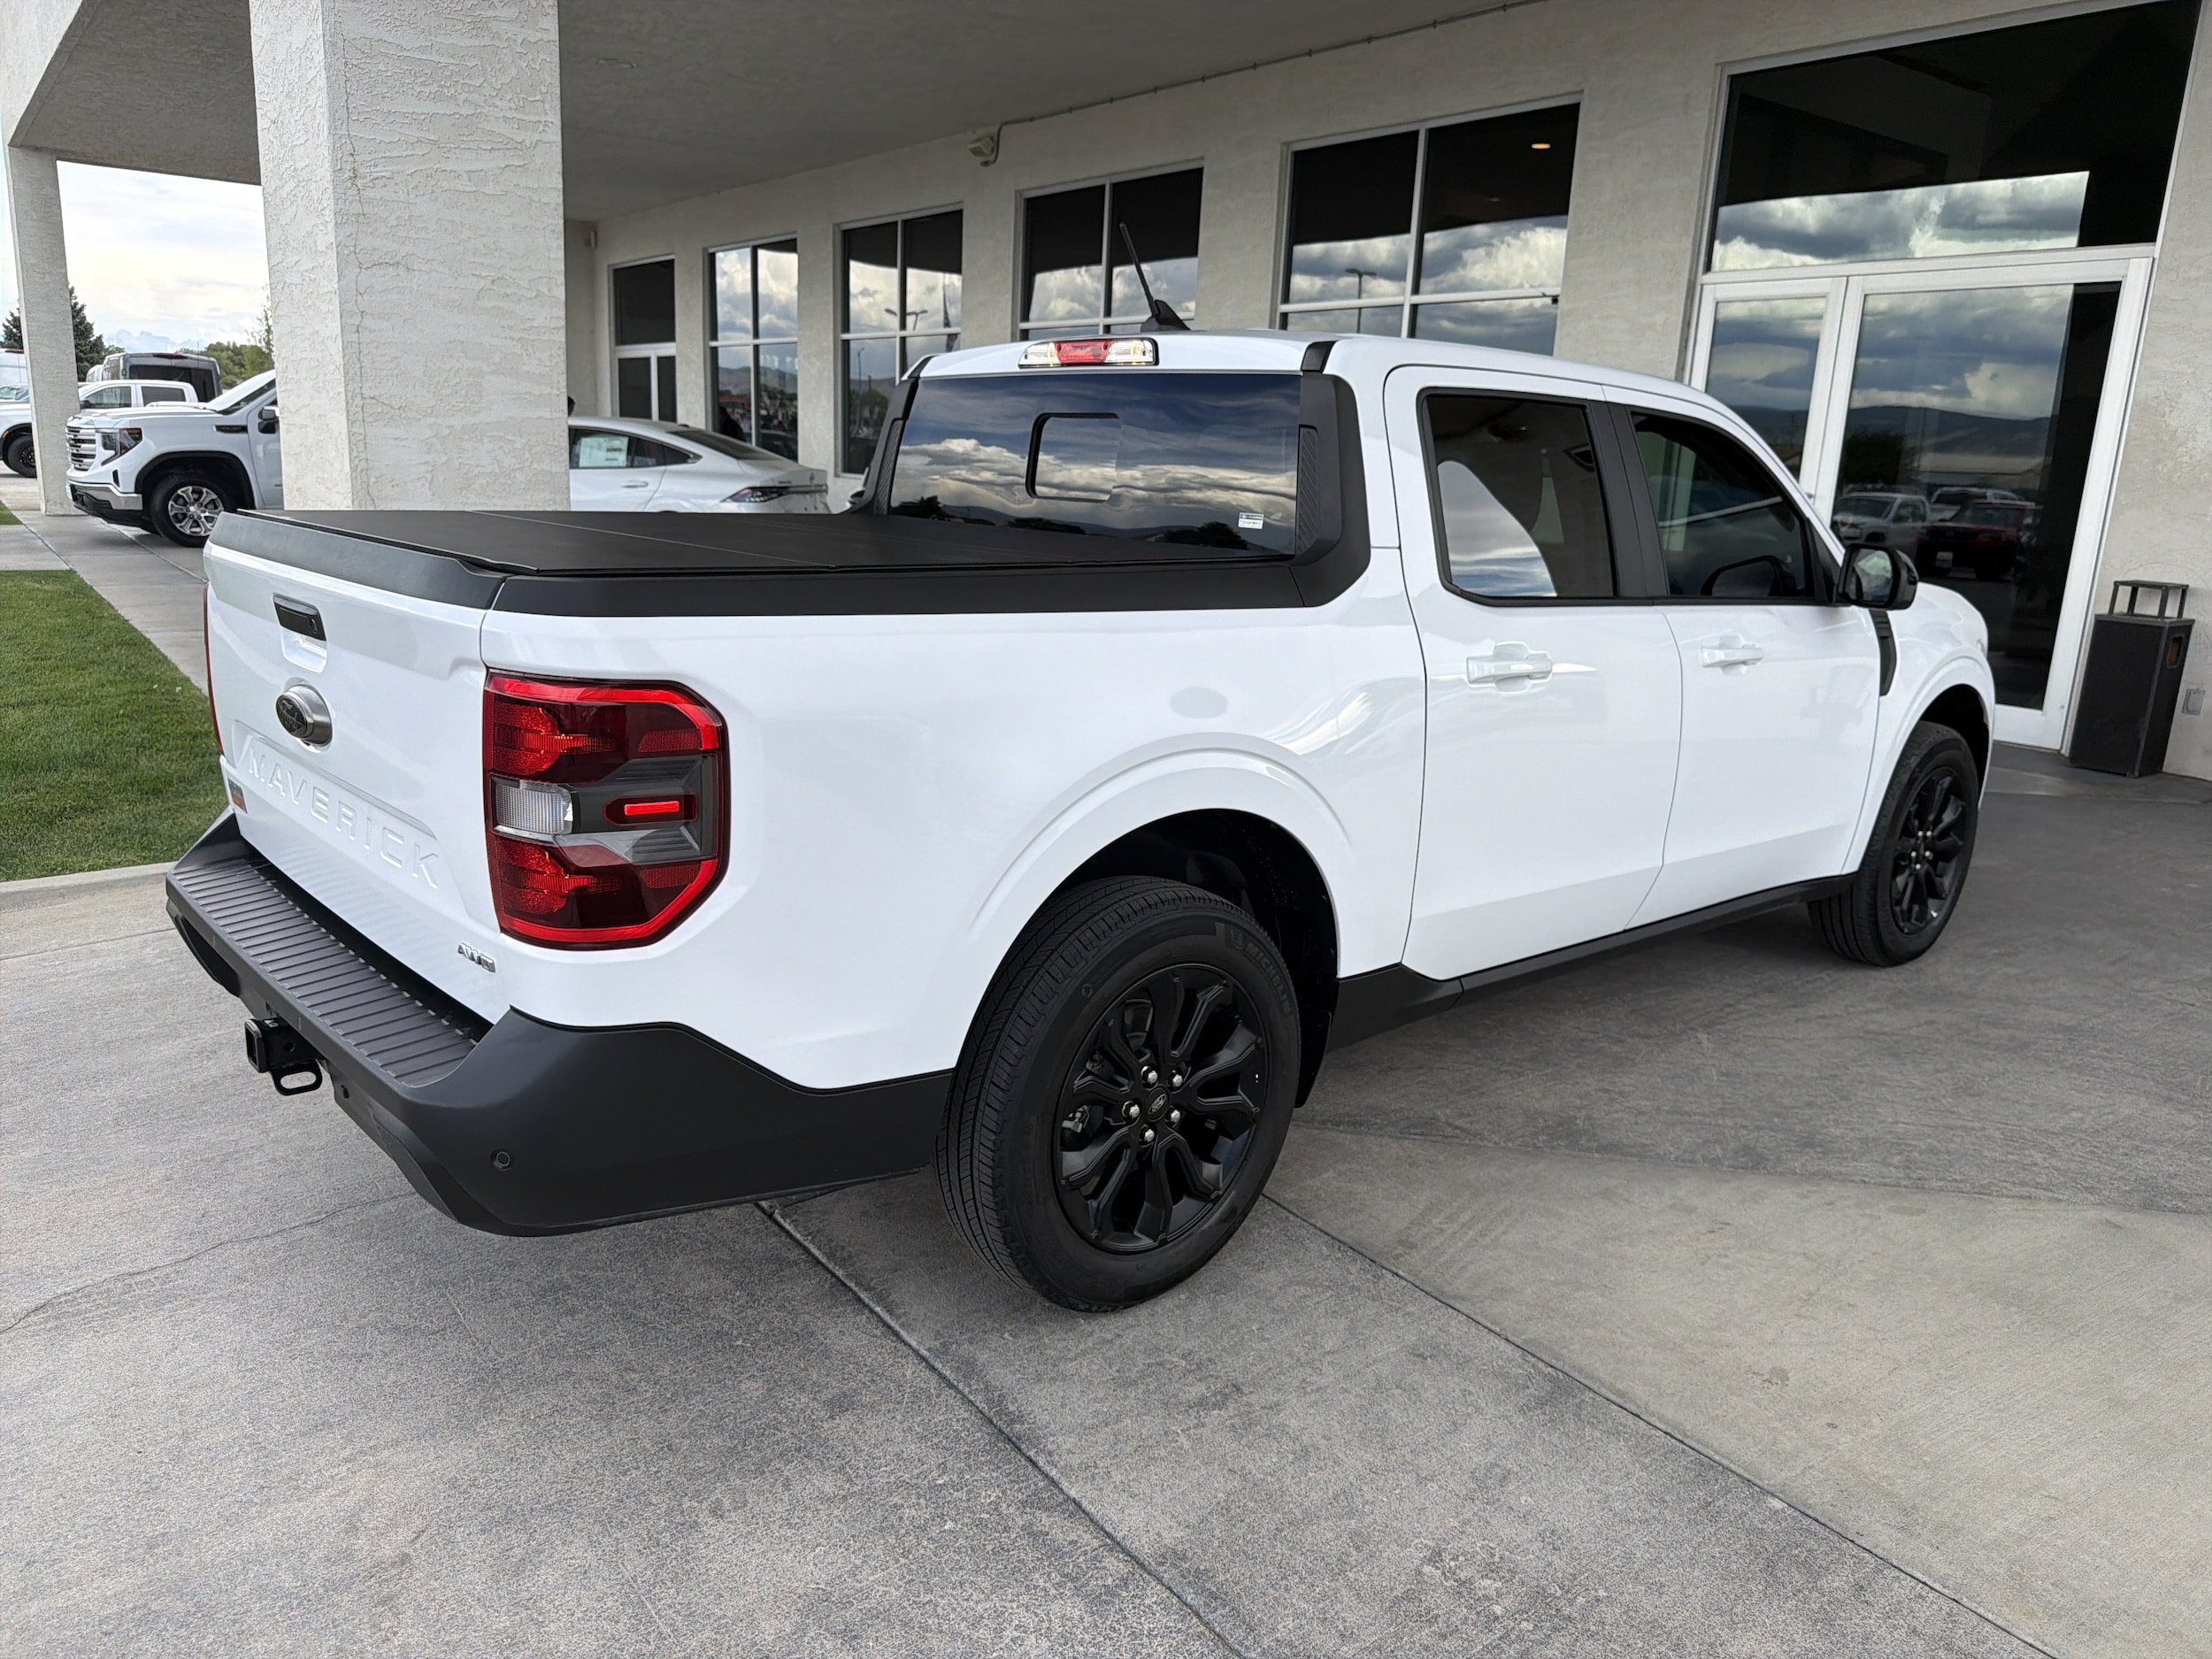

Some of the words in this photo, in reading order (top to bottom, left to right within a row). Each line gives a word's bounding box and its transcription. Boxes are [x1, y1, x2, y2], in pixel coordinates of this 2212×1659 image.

[248, 749, 440, 891] MAVERICK
[457, 942, 495, 972] AWD
[1244, 941, 1293, 1015] MICHELIN
